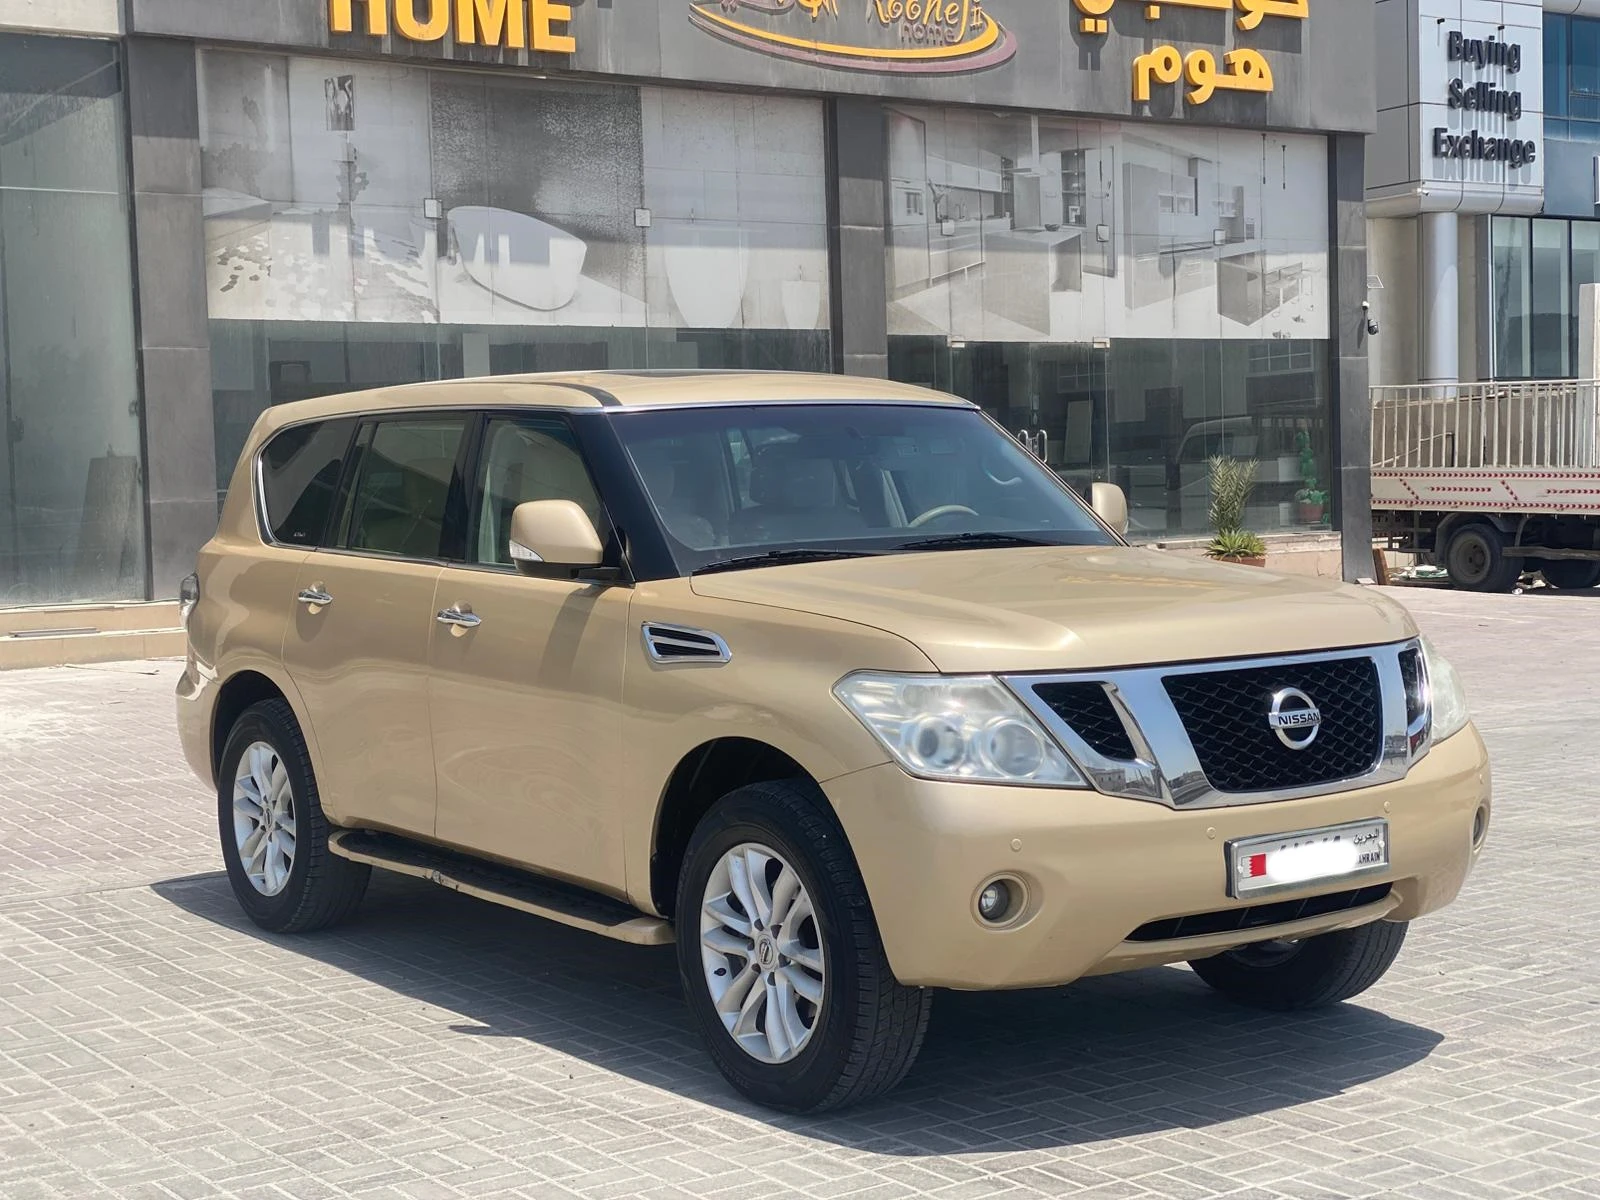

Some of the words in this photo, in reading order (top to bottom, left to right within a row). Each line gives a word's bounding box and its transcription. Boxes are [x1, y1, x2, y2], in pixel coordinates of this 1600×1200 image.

[1448, 30, 1522, 74] Buying
[1132, 45, 1274, 105] هوم
[1448, 78, 1522, 122] Selling
[1433, 127, 1536, 169] Exchange
[1278, 712, 1320, 726] NISSAN
[1358, 851, 1381, 864] AHRAIN
